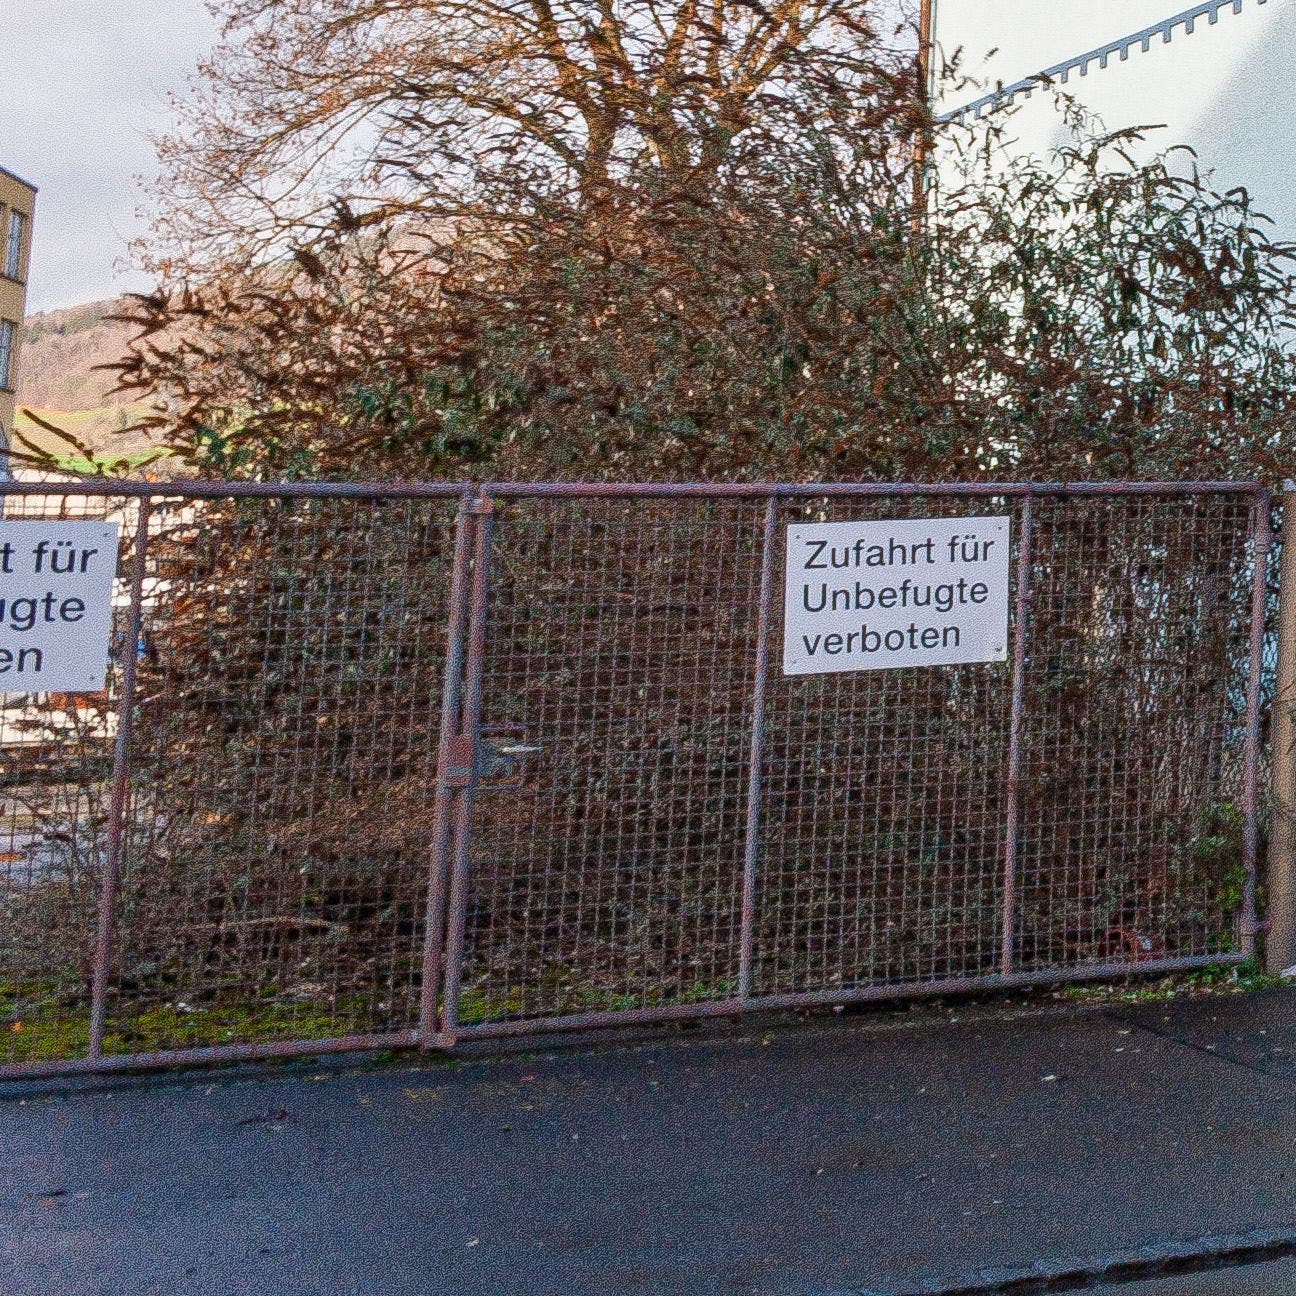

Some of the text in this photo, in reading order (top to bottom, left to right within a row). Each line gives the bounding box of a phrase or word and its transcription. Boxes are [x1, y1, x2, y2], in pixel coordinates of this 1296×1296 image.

[33, 541, 99, 573] für
[804, 534, 995, 570] Zufahrt für
[803, 578, 989, 612] Unbefugte
[803, 623, 961, 656] verboten
